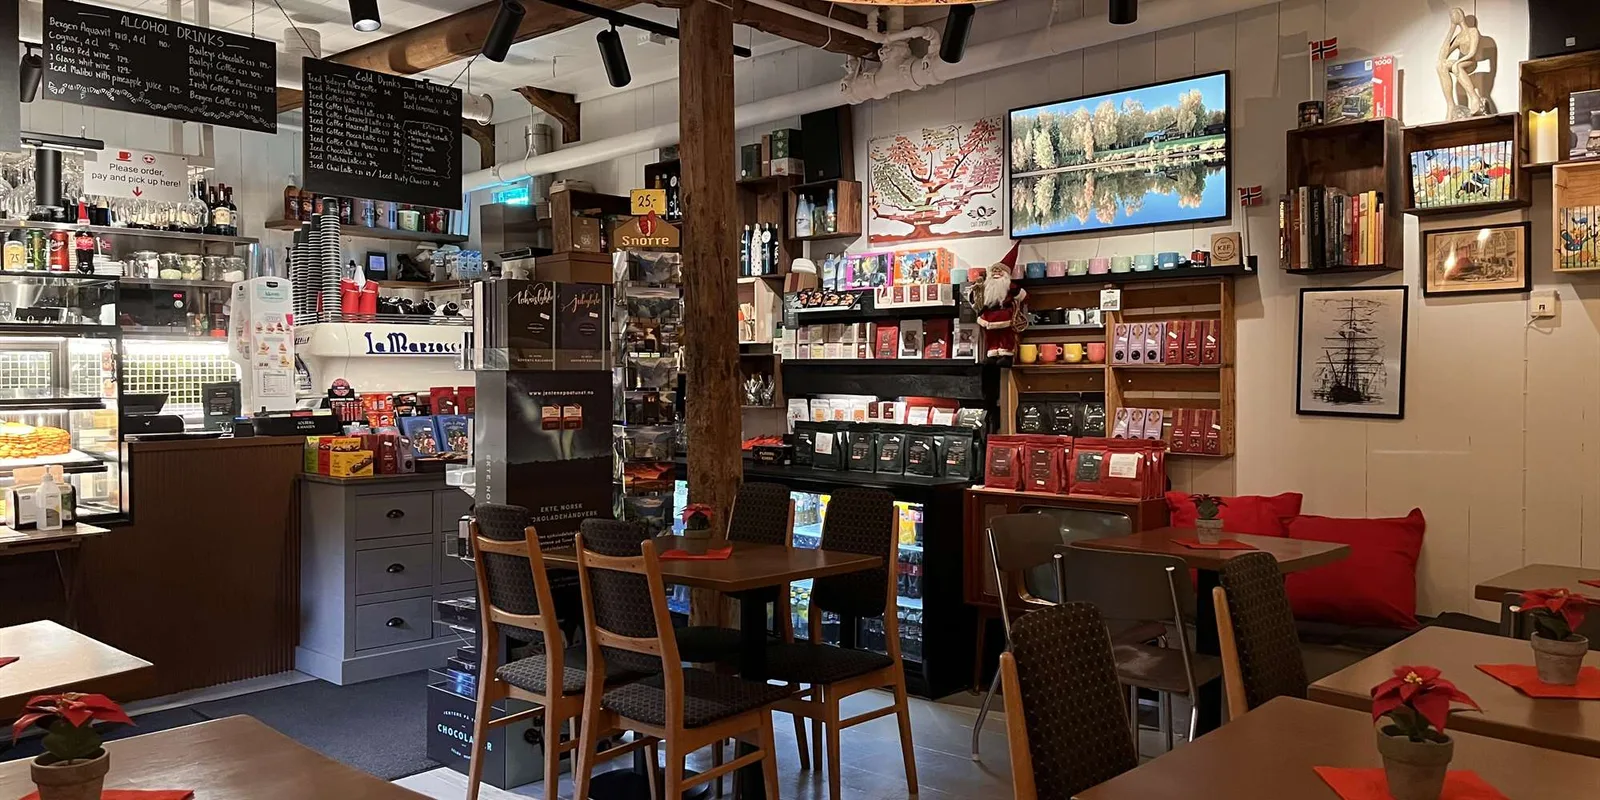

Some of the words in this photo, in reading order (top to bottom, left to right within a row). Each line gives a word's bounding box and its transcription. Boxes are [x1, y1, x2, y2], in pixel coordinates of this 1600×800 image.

[80, 22, 111, 37] Aquavit
[91, 38, 99, 47] cl
[177, 26, 224, 48] DRINKS
[56, 44, 75, 54] Glass
[77, 47, 90, 57] Red
[93, 51, 110, 60] wine
[189, 44, 215, 61] Baileys
[56, 54, 75, 64] Glass
[95, 62, 110, 71] wine
[189, 56, 213, 70] Baileys
[216, 62, 236, 73] Coffee
[49, 62, 67, 73] Iced
[70, 65, 93, 77] Malibu
[96, 71, 110, 81] with
[112, 75, 142, 87] pineapple
[145, 81, 162, 92] juice
[189, 67, 213, 82] Baileys
[214, 74, 234, 85] Coffee
[307, 73, 322, 83] Iced
[356, 71, 373, 83] Cold
[378, 74, 400, 89] Drinks
[189, 78, 208, 89] Irish
[210, 83, 230, 94] Coffee
[308, 83, 322, 91] Iced
[214, 96, 237, 107] Coffee
[309, 91, 323, 100] Iced
[325, 93, 342, 102] Coffee
[309, 100, 323, 109] Iced
[326, 102, 342, 111] Coffee
[309, 108, 323, 116] Iced
[326, 110, 342, 120] Coffee
[309, 116, 323, 125] Iced
[326, 118, 343, 128] Coffee
[309, 125, 323, 134] Iced
[326, 128, 344, 137] Coffee
[309, 134, 324, 143] Iced
[326, 137, 343, 146] Coffee
[309, 143, 324, 152] Iced
[110, 163, 138, 174] Please
[141, 168, 164, 177] order,
[309, 161, 324, 169] Iced
[379, 170, 392, 179] Iced
[91, 173, 107, 181] pay
[160, 178, 181, 187] here!
[638, 194, 656, 208] 25,-
[622, 236, 669, 246] Snorre
[364, 332, 386, 353] La
[437, 724, 492, 751] CHOCOLAR
